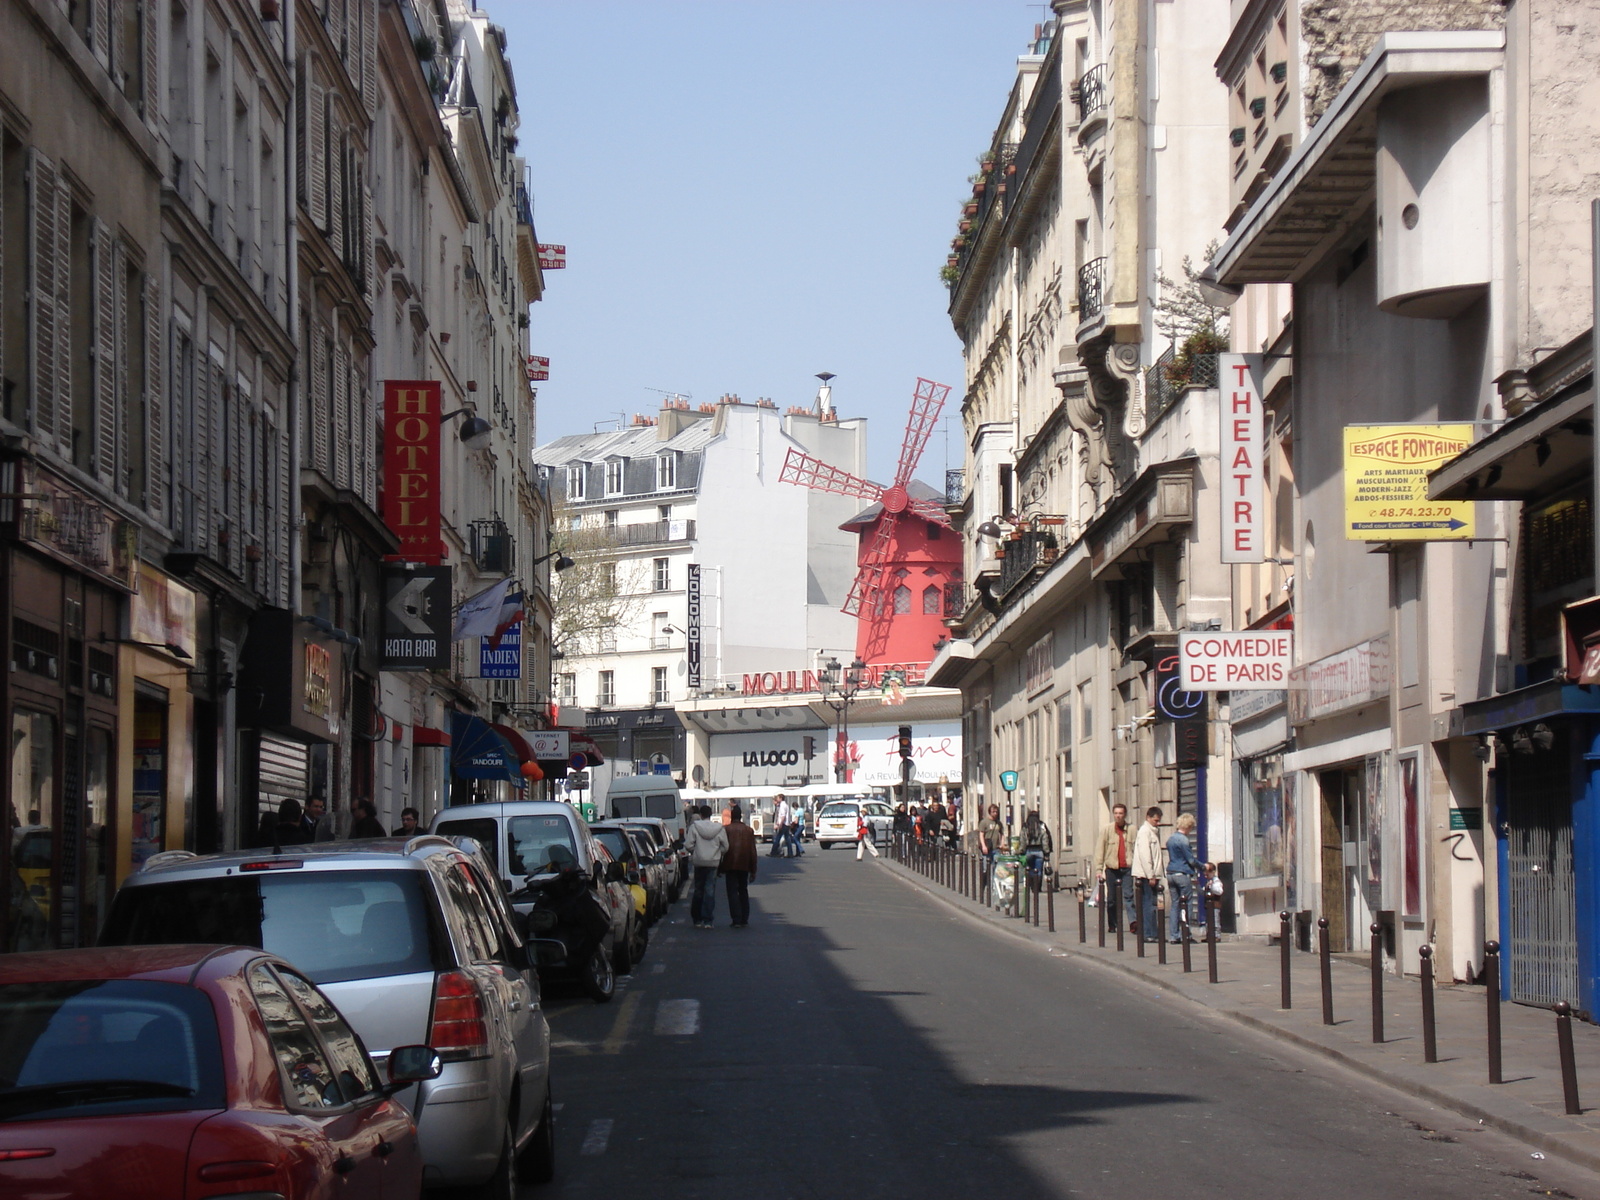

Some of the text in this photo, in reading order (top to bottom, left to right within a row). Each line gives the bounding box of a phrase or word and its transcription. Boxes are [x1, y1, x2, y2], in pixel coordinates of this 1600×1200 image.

[393, 389, 431, 526] HOTEL
[1232, 364, 1253, 552] THEATRE
[1353, 438, 1465, 460] ESPACE FONTAINE
[1356, 477, 1409, 485] MUSCULATION
[1385, 468, 1424, 476] MARTIAUX
[1354, 494, 1414, 502] ABDOS-FESSIERS
[1358, 485, 1412, 493] MODERN-JAZZ
[1379, 507, 1452, 517] 48.74.23.70
[688, 568, 700, 686] LOCOMOTIVE
[385, 639, 437, 657] KATA BAR
[482, 650, 519, 664] INDIEN
[1185, 638, 1288, 658] COMEDIE
[743, 663, 919, 696] MOULIN ROUE
[1190, 664, 1217, 683] DE
[1226, 662, 1283, 682] PARIS
[472, 758, 503, 766] TANDOURI
[742, 749, 799, 768] LA LOCO
[864, 772, 875, 781] LA
[917, 769, 947, 779] MOULIN
